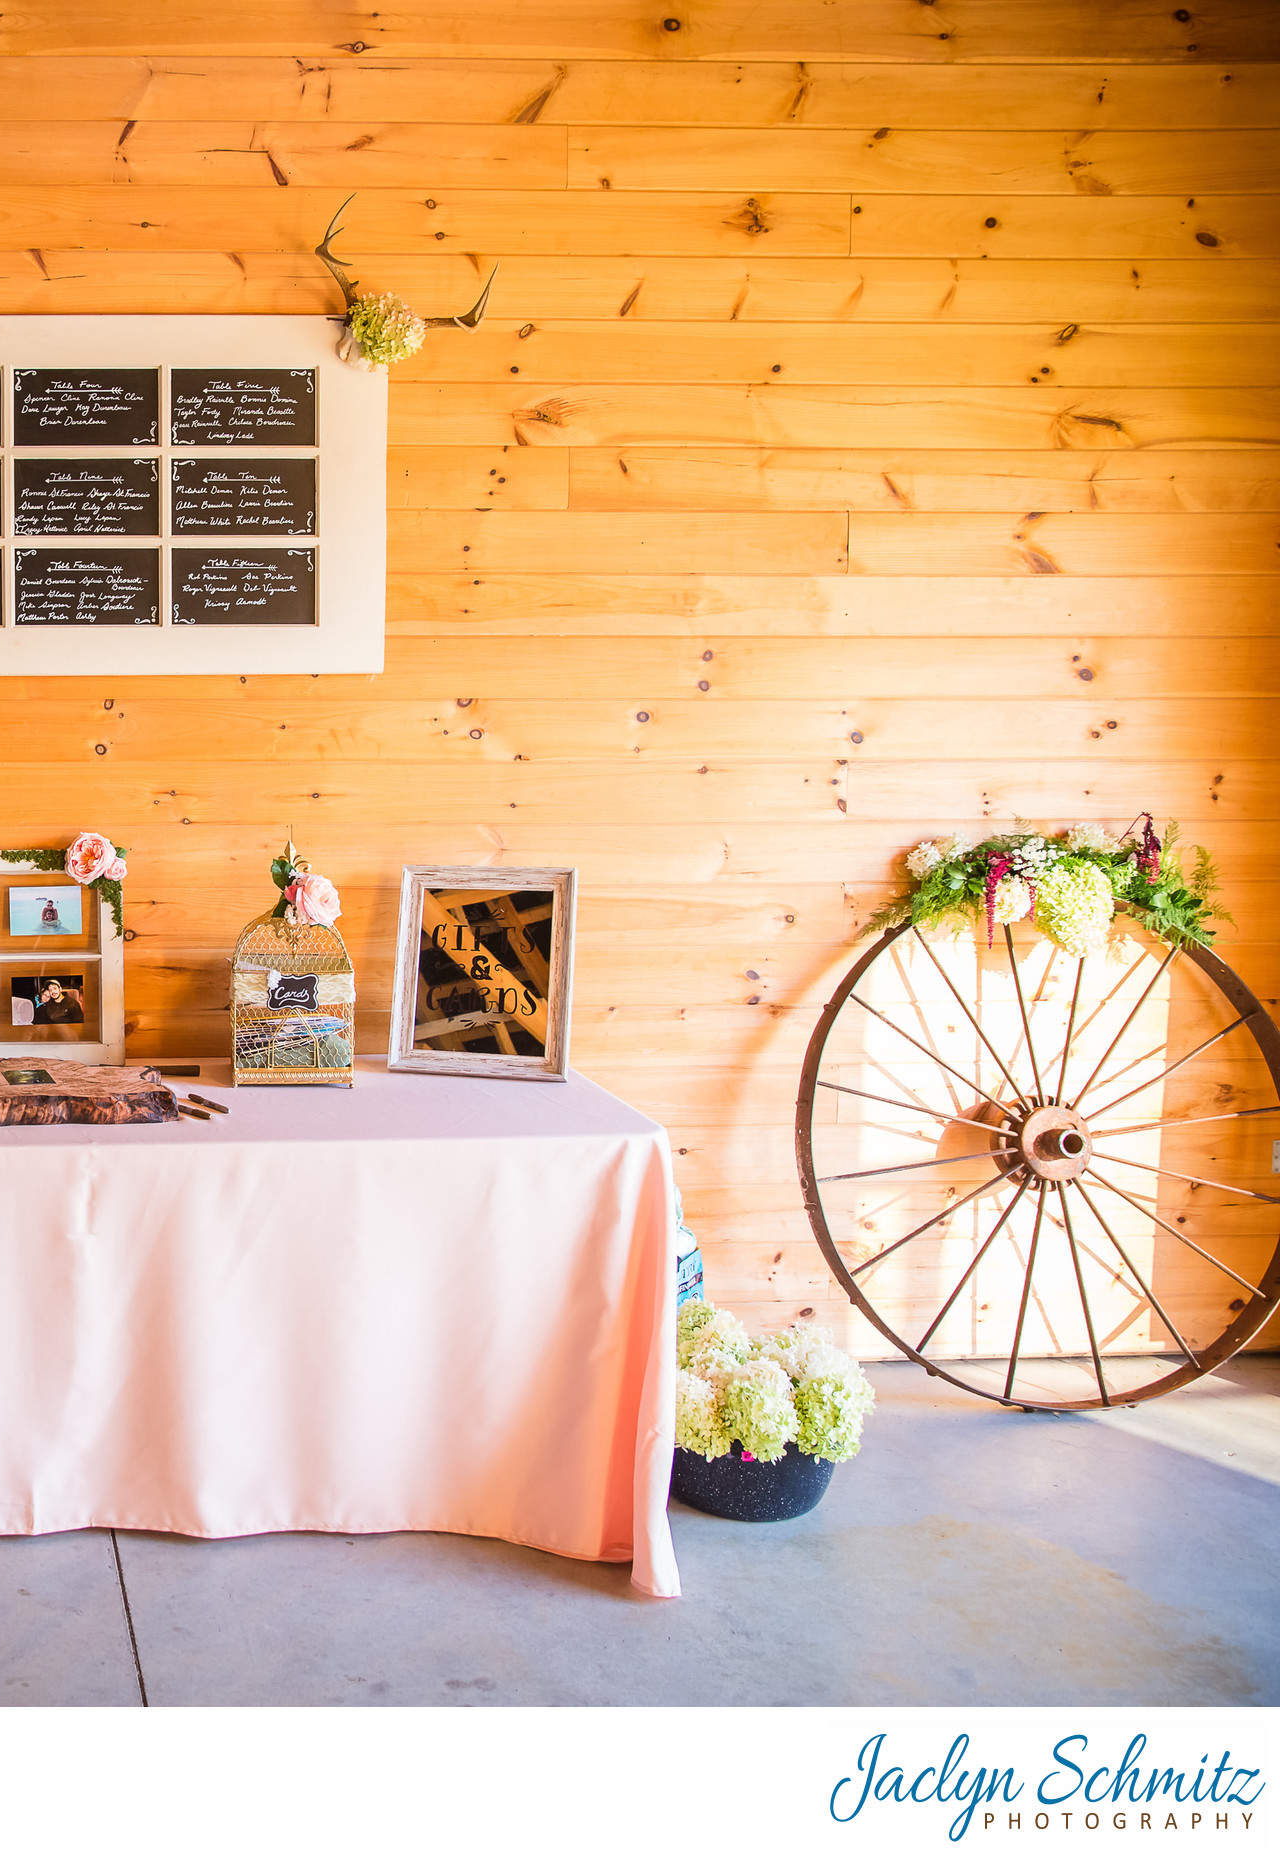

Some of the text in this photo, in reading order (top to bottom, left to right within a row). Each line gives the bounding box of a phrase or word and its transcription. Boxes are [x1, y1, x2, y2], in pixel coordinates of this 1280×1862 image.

[51, 380, 102, 389] Table Four
[208, 381, 263, 389] Table Five
[24, 394, 55, 403] Spencer
[177, 395, 203, 409] Bradley
[174, 408, 196, 419] Taylor
[233, 407, 264, 415] Miranda
[50, 472, 71, 480] Table
[207, 471, 257, 479] Table Ten
[82, 502, 101, 515] Riley
[176, 501, 198, 510] Allen
[74, 514, 91, 523] Lucy
[176, 516, 231, 528] Matthew White
[236, 515, 294, 525] Rachel Beaulieu
[74, 523, 92, 532] April
[50, 561, 107, 569] Table Fourteen
[208, 559, 264, 567] Table Fifteen
[21, 591, 44, 600] Jessica
[18, 602, 35, 611] Mike
[48, 612, 69, 620] Porter
[76, 612, 96, 622] Ashley
[432, 923, 538, 953] GIFTS
[471, 955, 493, 980] &
[274, 986, 310, 1004] Cards
[426, 986, 537, 1016] CARDS
